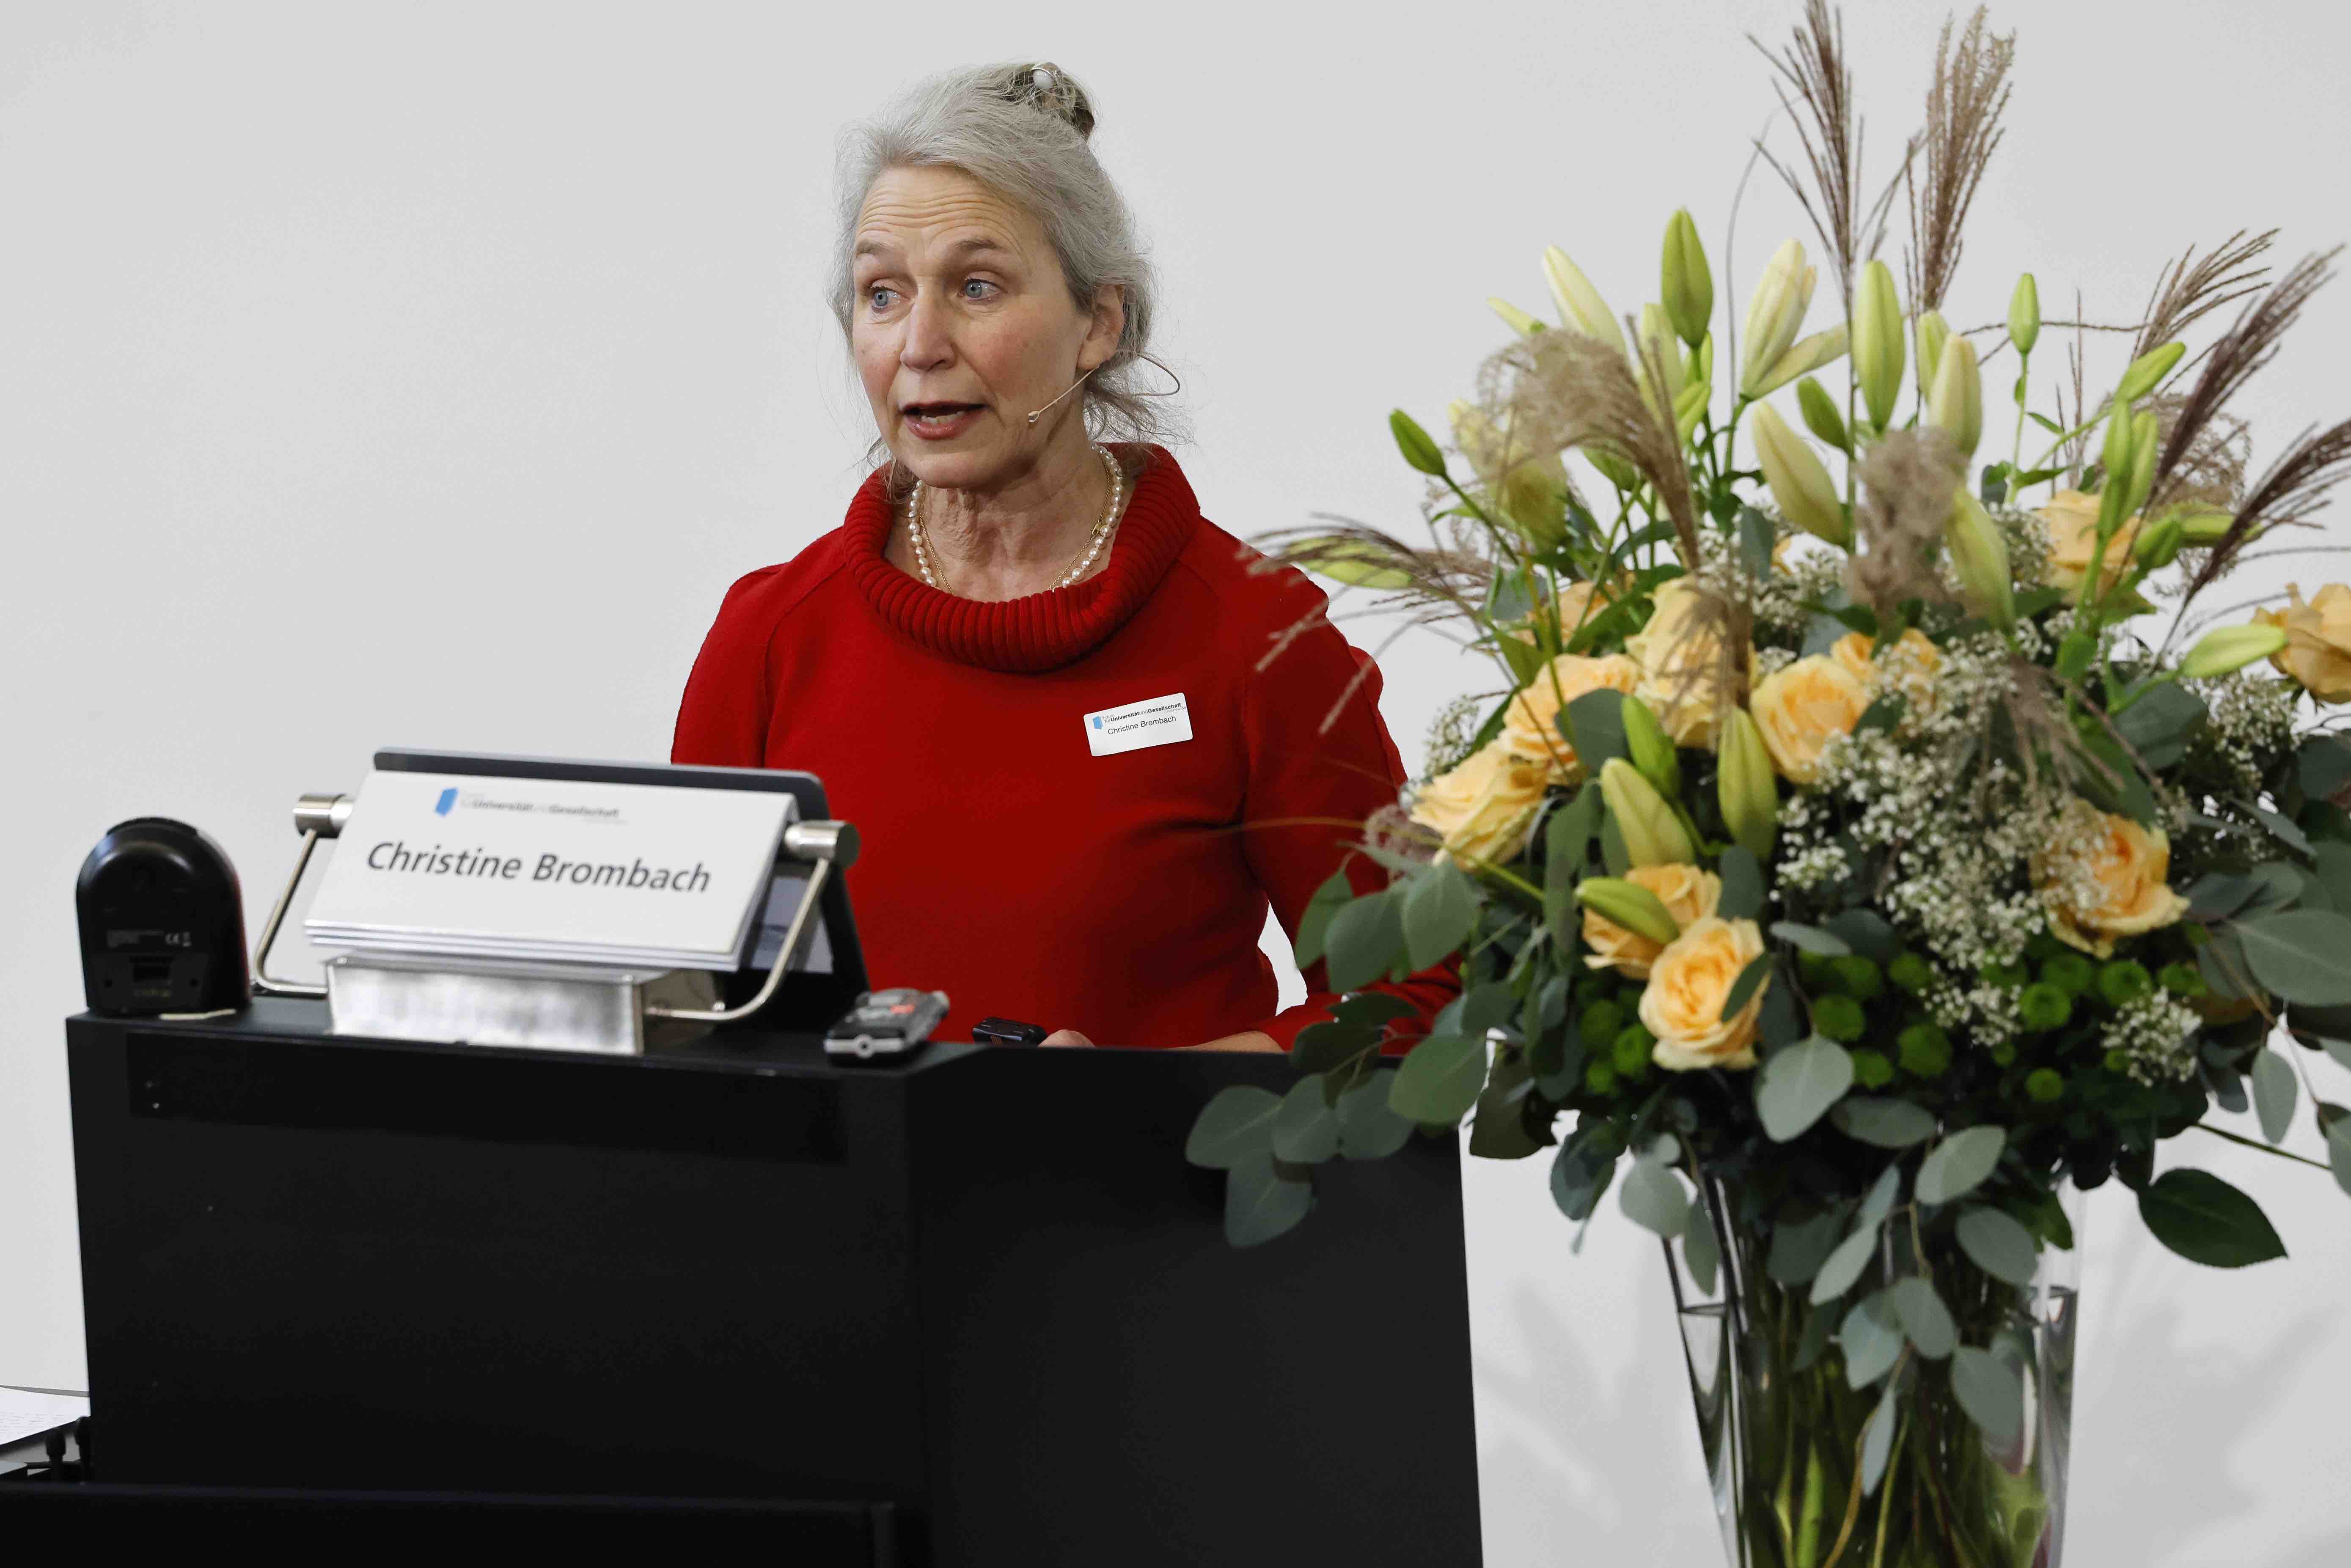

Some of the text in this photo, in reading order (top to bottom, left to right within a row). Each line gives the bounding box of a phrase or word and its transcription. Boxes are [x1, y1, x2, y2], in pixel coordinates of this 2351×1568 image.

[1108, 715, 1177, 735] Christine Brombach
[367, 840, 711, 892] Christine Brombach
